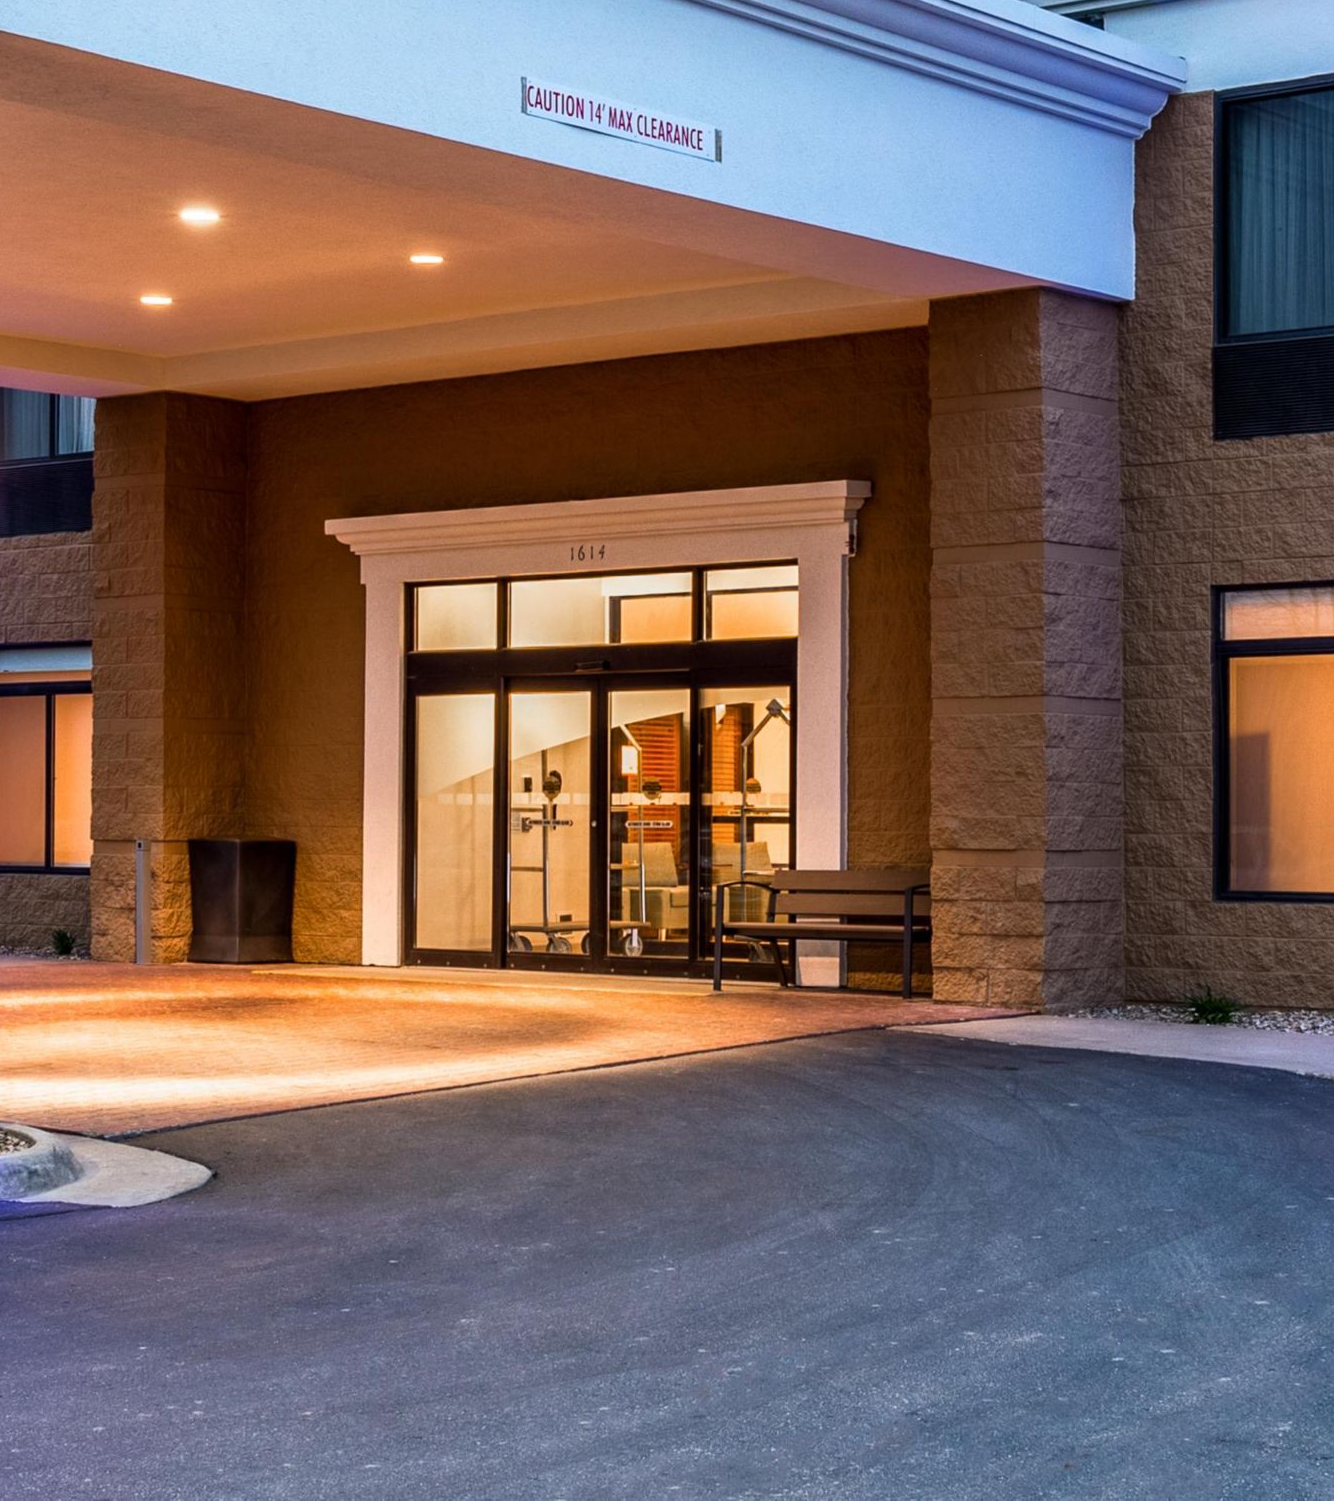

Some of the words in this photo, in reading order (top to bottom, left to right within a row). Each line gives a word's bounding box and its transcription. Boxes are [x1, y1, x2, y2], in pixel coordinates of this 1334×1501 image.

[526, 85, 585, 120] CAUTION
[608, 105, 633, 133] MAX
[636, 114, 704, 151] CLEARANCE
[570, 544, 606, 561] 1614
